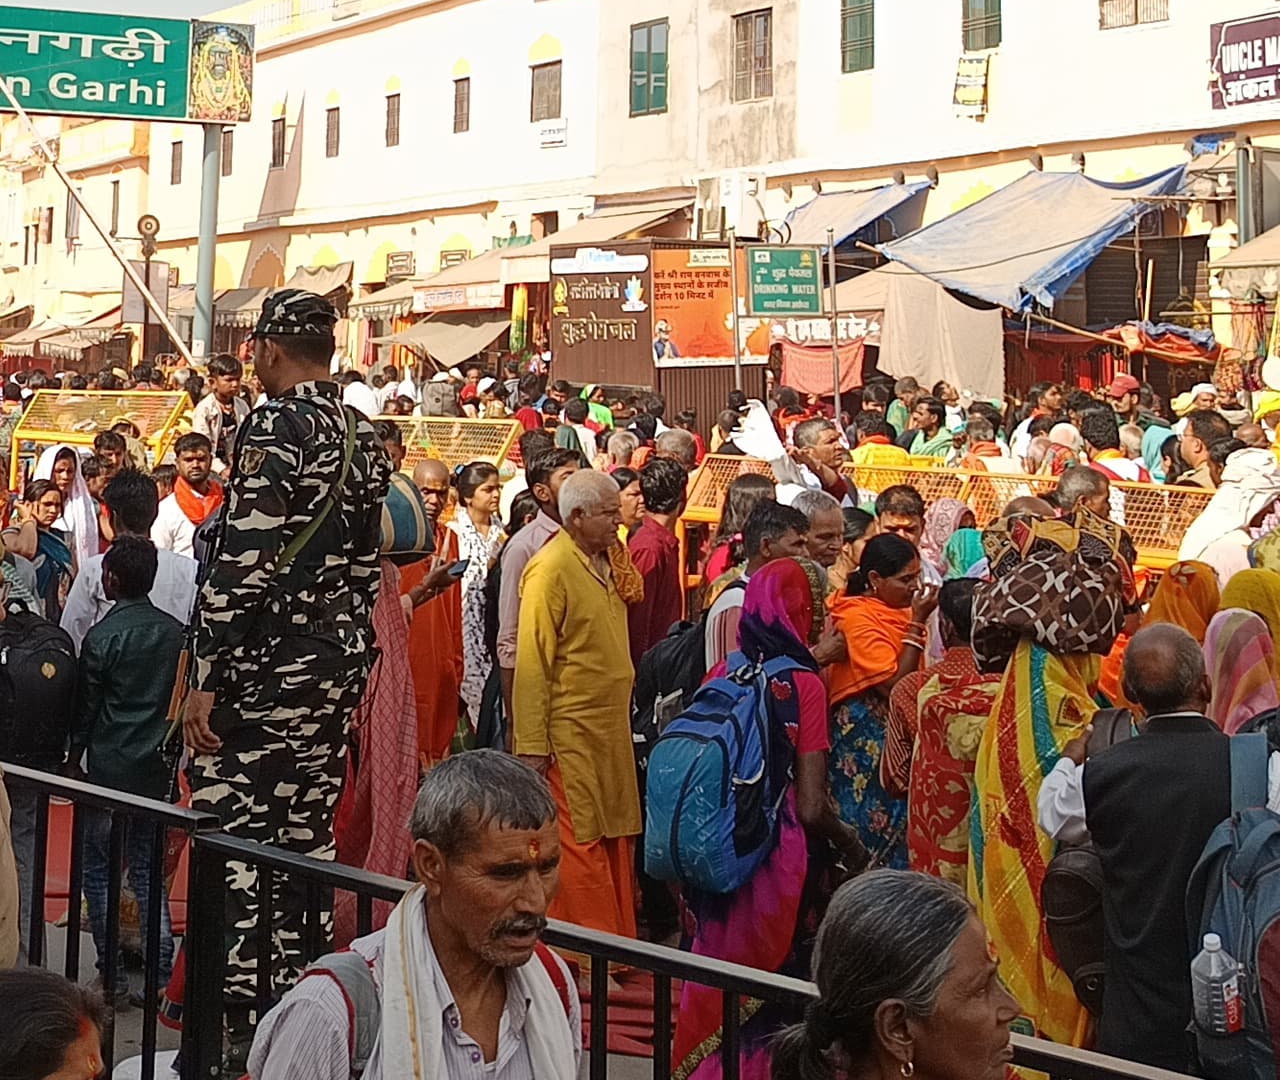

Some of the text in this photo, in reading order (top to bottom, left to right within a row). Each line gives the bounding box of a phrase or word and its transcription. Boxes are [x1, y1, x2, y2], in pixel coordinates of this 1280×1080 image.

[1222, 39, 1263, 74] UNCLE
[48, 72, 168, 107] Garhi
[1225, 74, 1277, 103] अंकल
[675, 291, 685, 300] 10
[754, 284, 816, 294] DRINKING WATER
